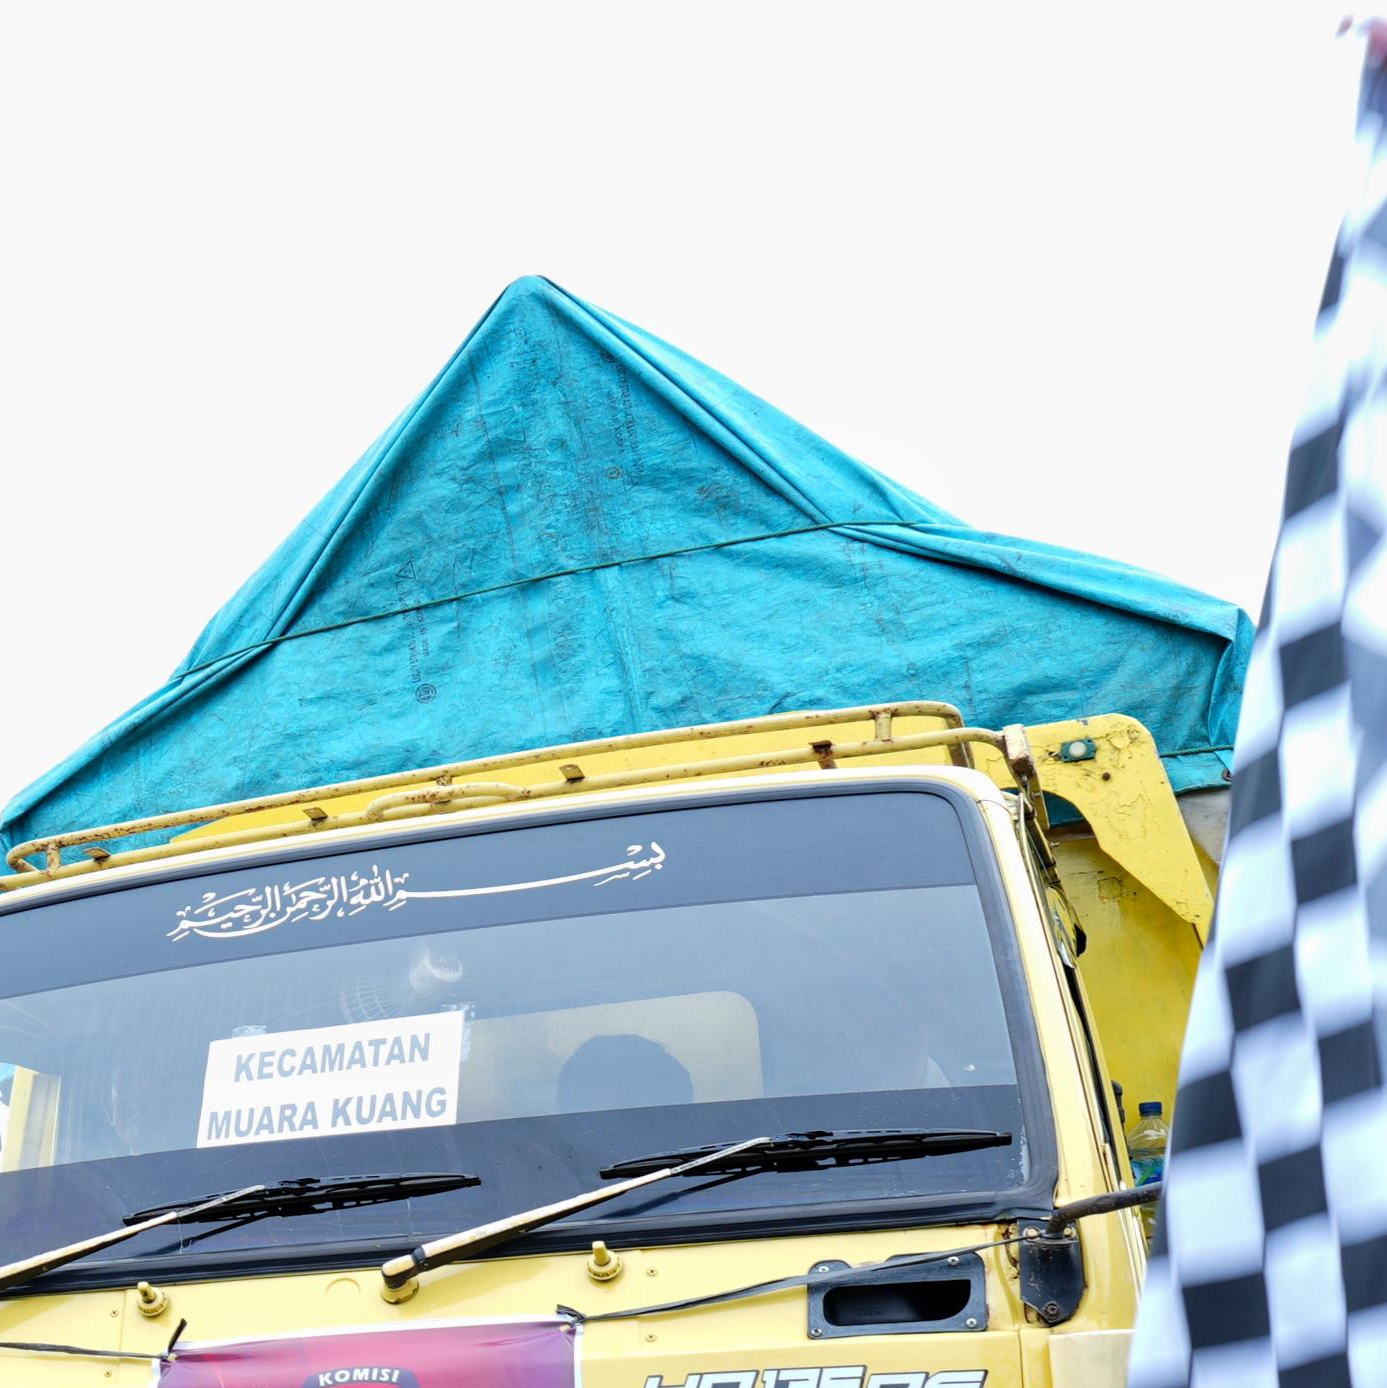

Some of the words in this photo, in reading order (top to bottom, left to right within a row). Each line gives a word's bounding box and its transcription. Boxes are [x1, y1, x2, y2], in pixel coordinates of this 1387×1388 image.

[234, 1033, 430, 1082] KECAMATAN
[207, 1101, 319, 1140] MUARA
[331, 1087, 447, 1129] KUANG
[318, 1367, 400, 1387] KOMISI
